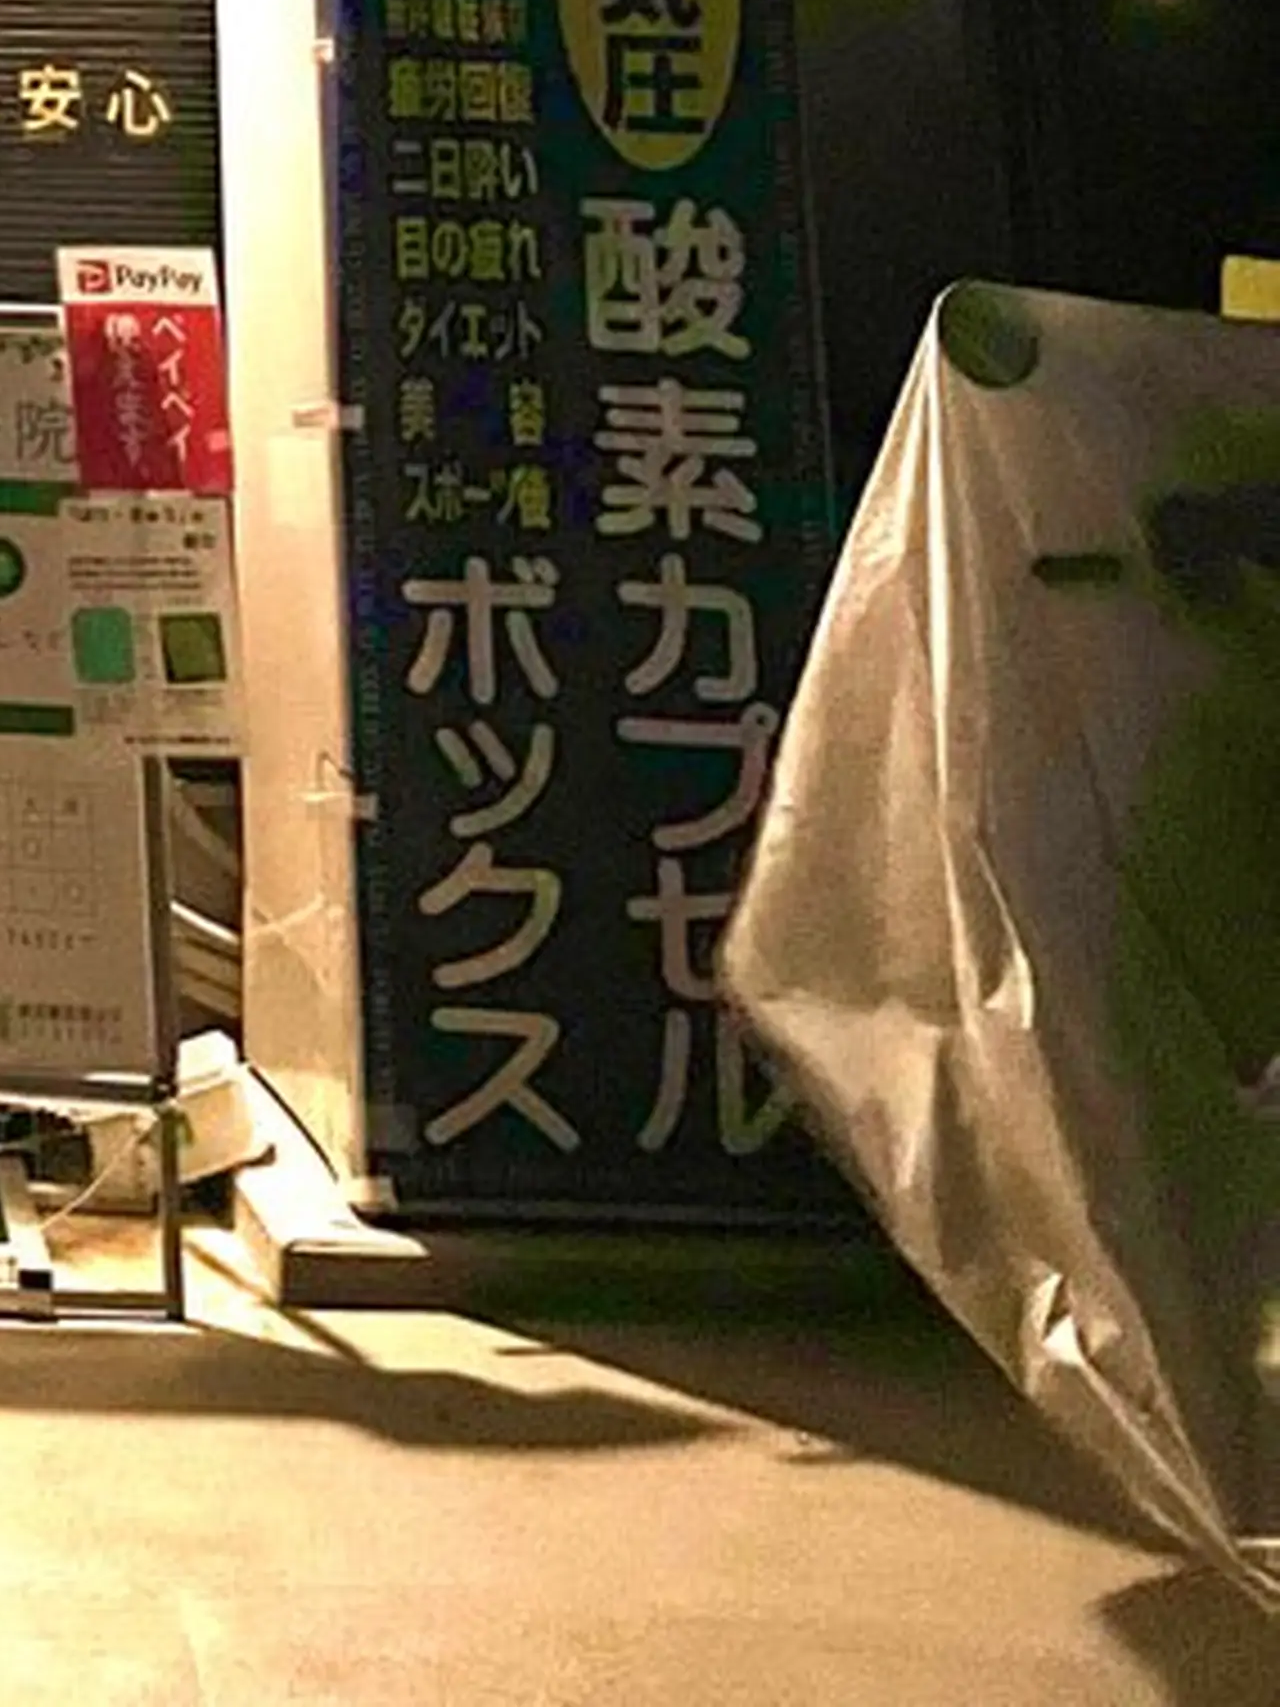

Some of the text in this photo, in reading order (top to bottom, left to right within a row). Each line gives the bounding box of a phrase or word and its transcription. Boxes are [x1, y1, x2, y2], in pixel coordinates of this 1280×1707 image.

[390, 139, 539, 200] 二日酔い
[115, 264, 204, 294] PayPay
[395, 214, 541, 281] 目の疲れ
[397, 295, 542, 361] ダイエット
[401, 555, 581, 1153] ボックス
